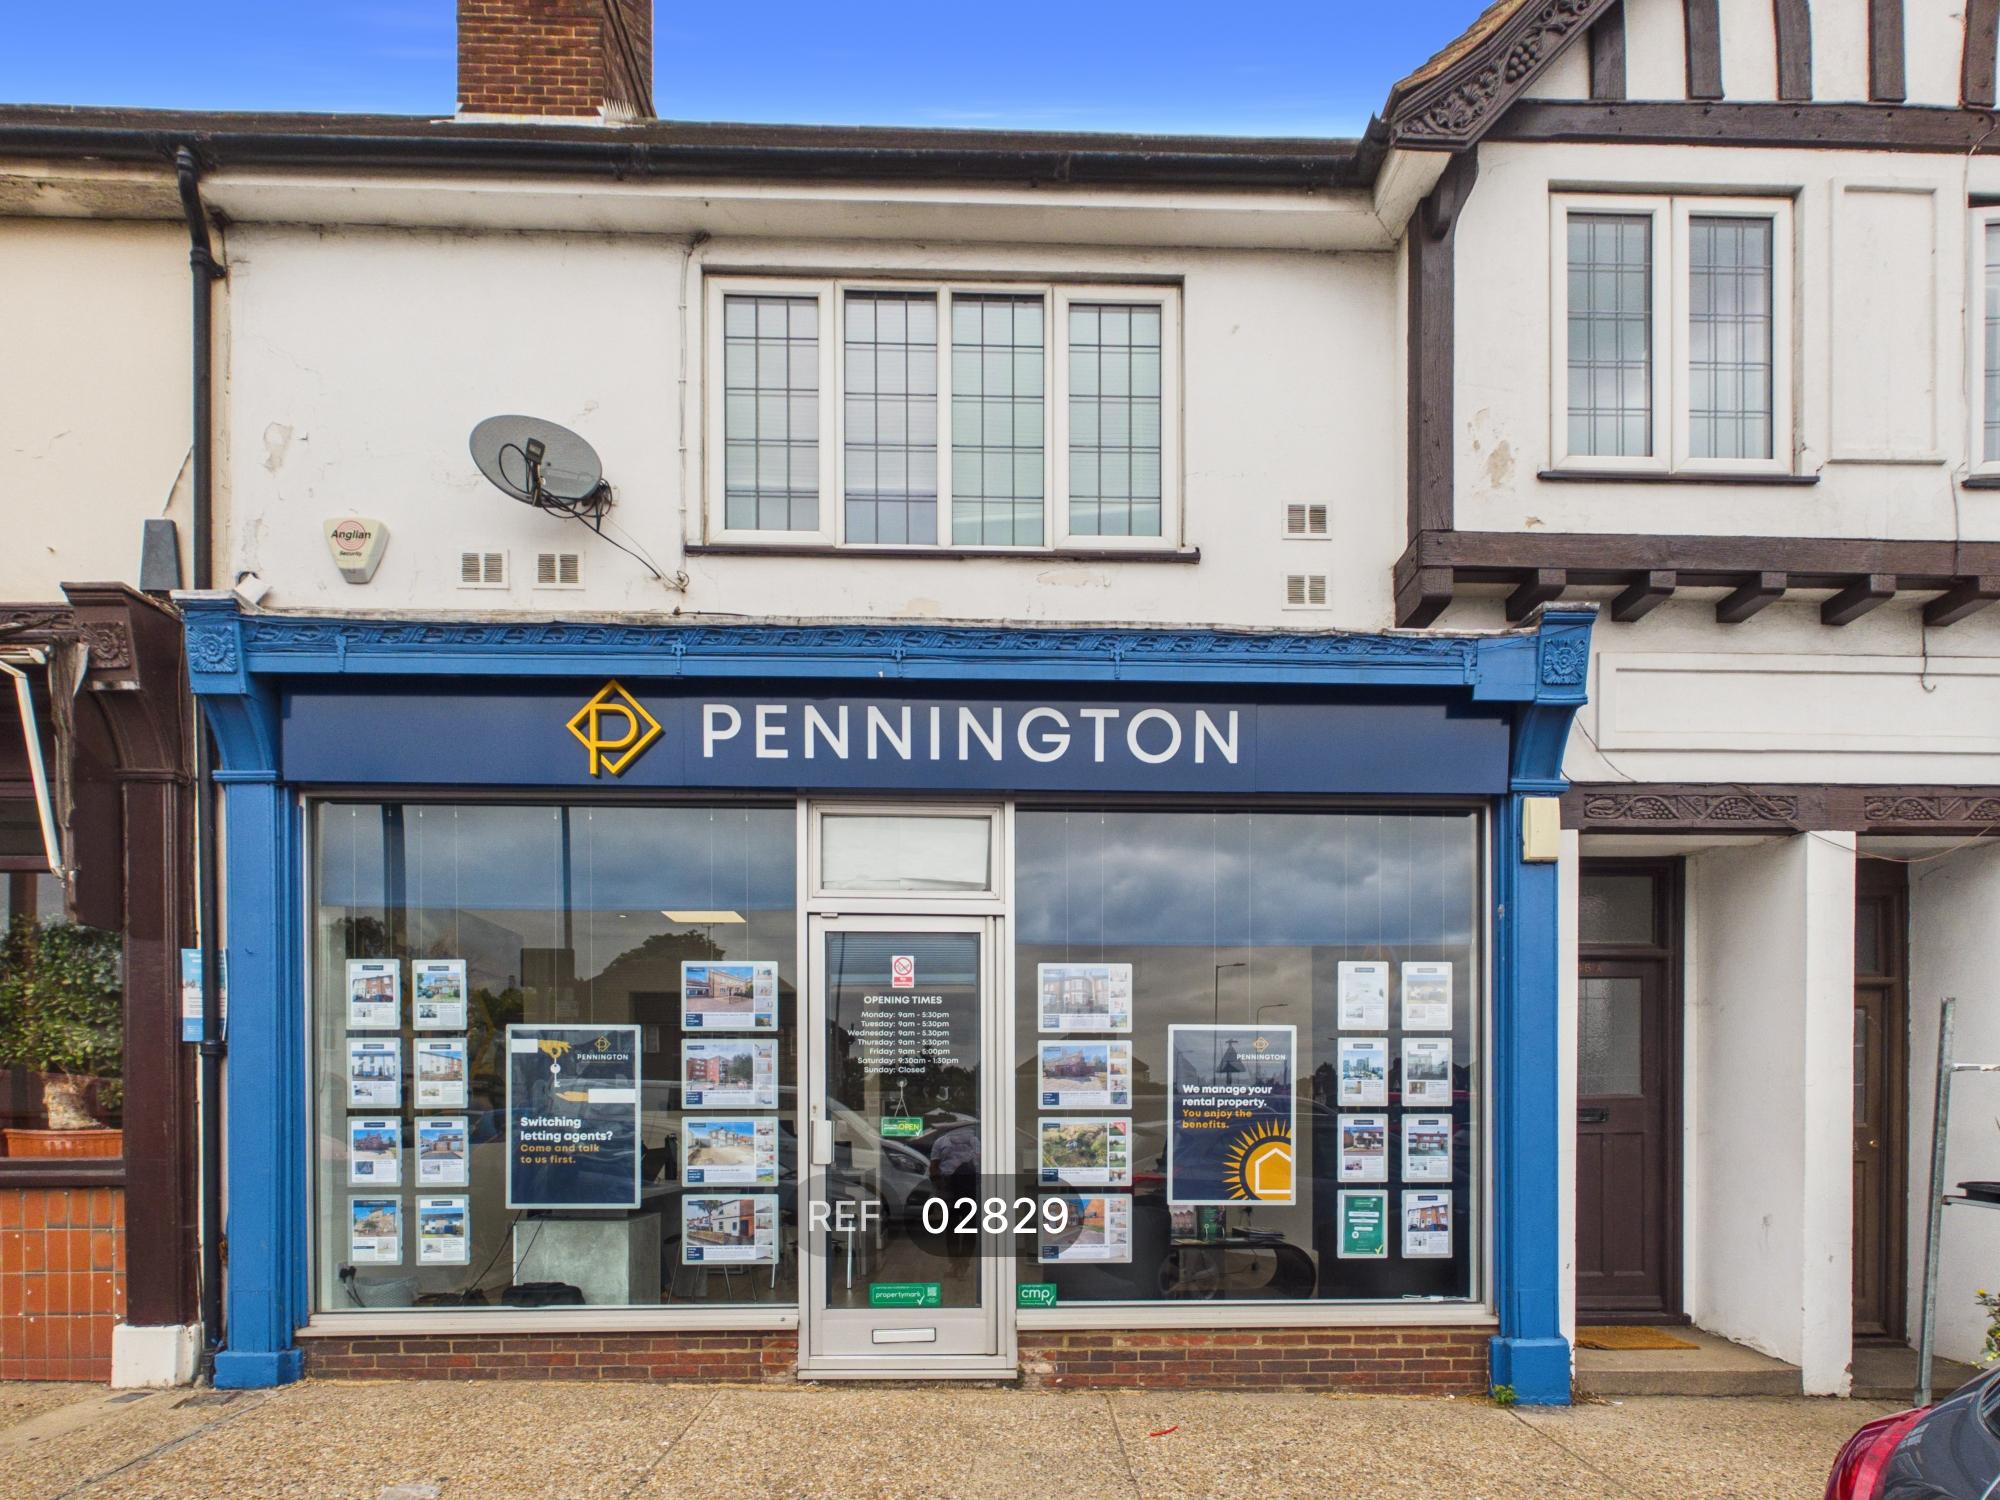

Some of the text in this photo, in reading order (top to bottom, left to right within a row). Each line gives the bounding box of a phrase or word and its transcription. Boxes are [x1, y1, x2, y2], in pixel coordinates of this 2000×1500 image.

[330, 530, 371, 541] Anglian
[703, 704, 1239, 763] PENNINGTON
[864, 996, 942, 1004] OPENING TIMES
[870, 1048, 896, 1056] Friday:
[858, 1057, 896, 1065] Saturday:
[933, 1057, 959, 1065] 1:30pm
[864, 1066, 896, 1074] Sunday:
[1183, 1084, 1272, 1096] We manage your
[1183, 1097, 1267, 1108] rental property.
[1183, 1110, 1252, 1119] You enjoy the
[520, 1117, 581, 1128] Switching
[1183, 1120, 1229, 1128] benefits.
[520, 1131, 613, 1142] letting agents?
[520, 1144, 599, 1152] Come and talk
[520, 1156, 532, 1164] to
[550, 1156, 576, 1164] first.
[876, 1291, 921, 1299] propertymark
[1022, 1290, 1050, 1301] cmp
